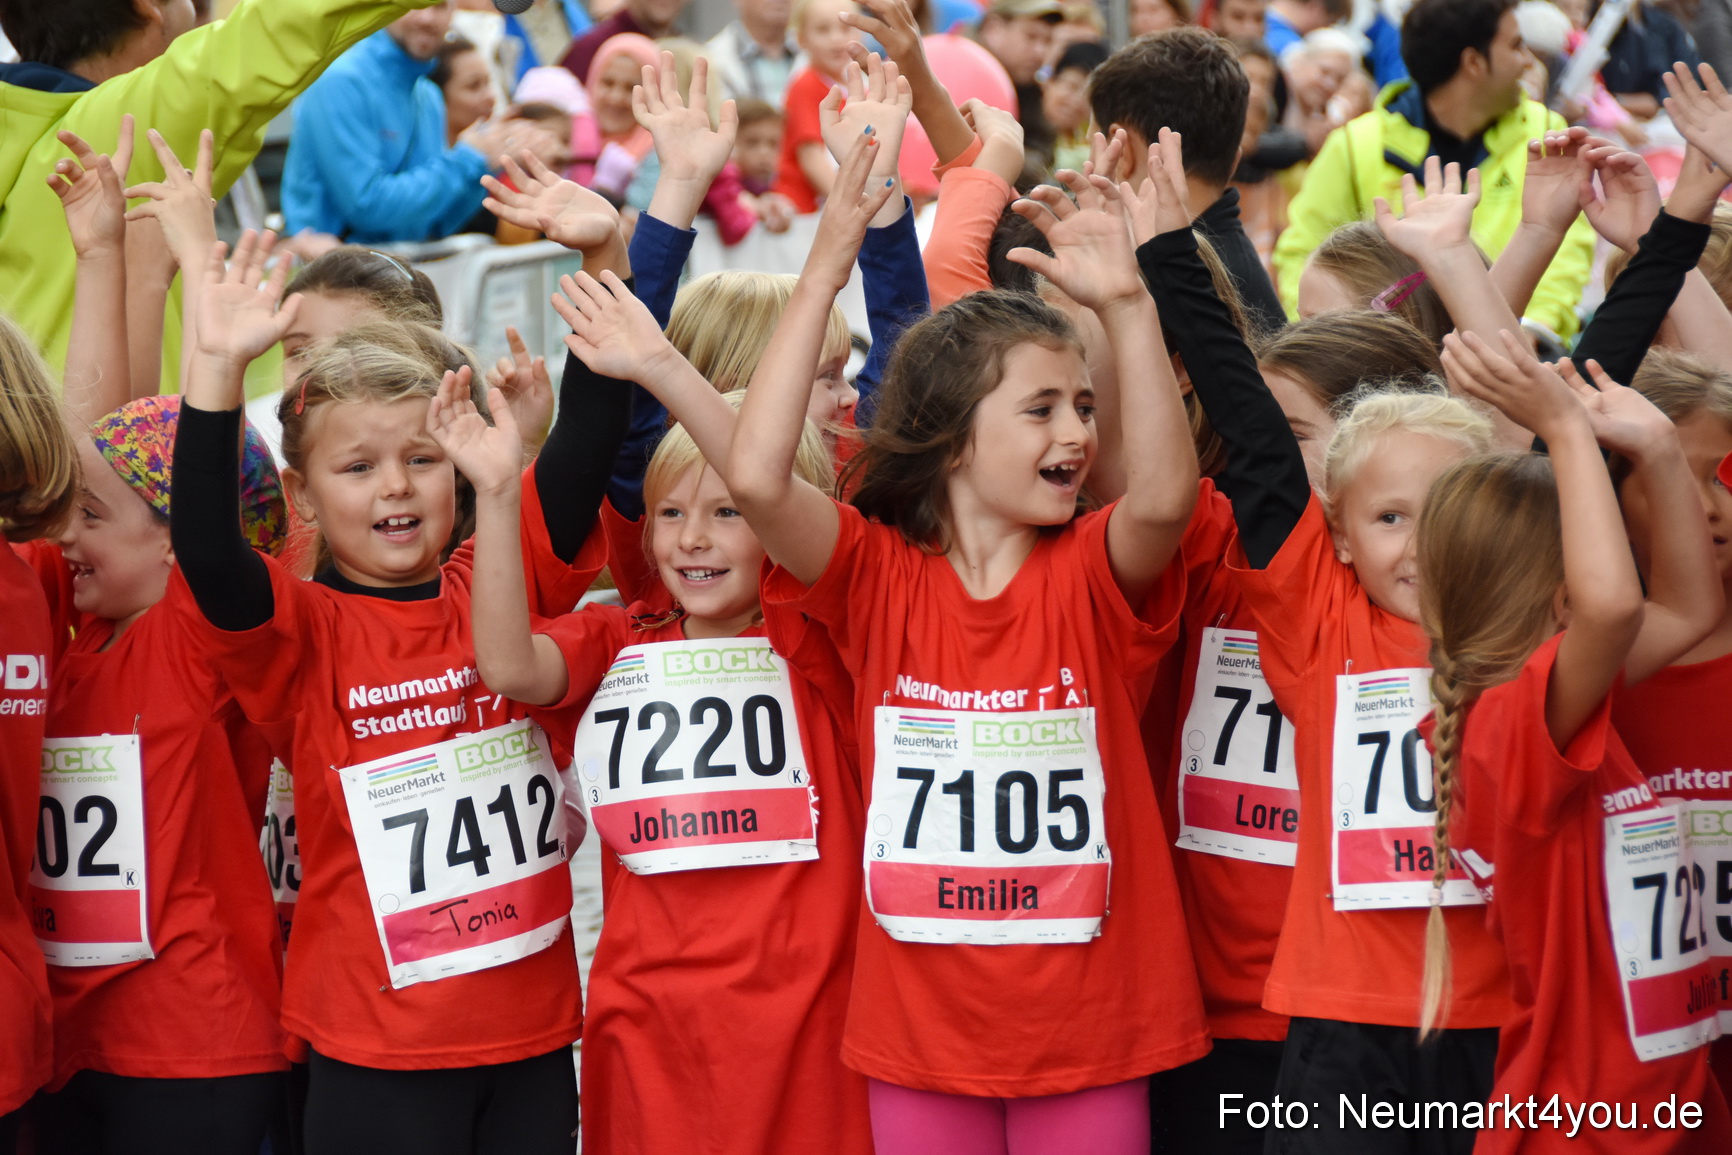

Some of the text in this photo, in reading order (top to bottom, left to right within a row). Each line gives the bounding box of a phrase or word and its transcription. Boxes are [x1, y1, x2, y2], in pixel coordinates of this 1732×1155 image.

[663, 647, 780, 677] BOCK
[597, 672, 650, 693] euerMarkt
[664, 674, 782, 688] inspired by smart concepts
[895, 674, 1028, 710] Neumarkter
[352, 696, 467, 739] Stadtlauf
[1354, 696, 1415, 713] NeuerMarkt
[594, 694, 786, 789] 7220
[893, 734, 959, 750] NeuerMarkt
[972, 718, 1085, 748] BOCK
[41, 746, 117, 773] OCK
[454, 726, 541, 774] BOCK
[972, 745, 1087, 759] inspired by smart concepts
[460, 768, 491, 783] inspired
[492, 765, 502, 774] by
[503, 761, 523, 771] smart
[792, 770, 802, 784] K
[1189, 757, 1198, 773] 3
[367, 771, 446, 801] NeuerMarkt
[1648, 767, 1732, 794] arkter
[592, 789, 599, 803] 3
[897, 766, 1091, 854] 7105
[1342, 813, 1350, 826] 3
[34, 795, 120, 878] 02
[382, 774, 559, 894] 7412
[630, 806, 758, 844] Johanna
[876, 843, 885, 858] 3
[1096, 844, 1105, 860] K
[126, 871, 135, 885] K
[938, 876, 1039, 911] Emilia
[429, 898, 519, 937] Tonia
[1629, 960, 1638, 976] 3
